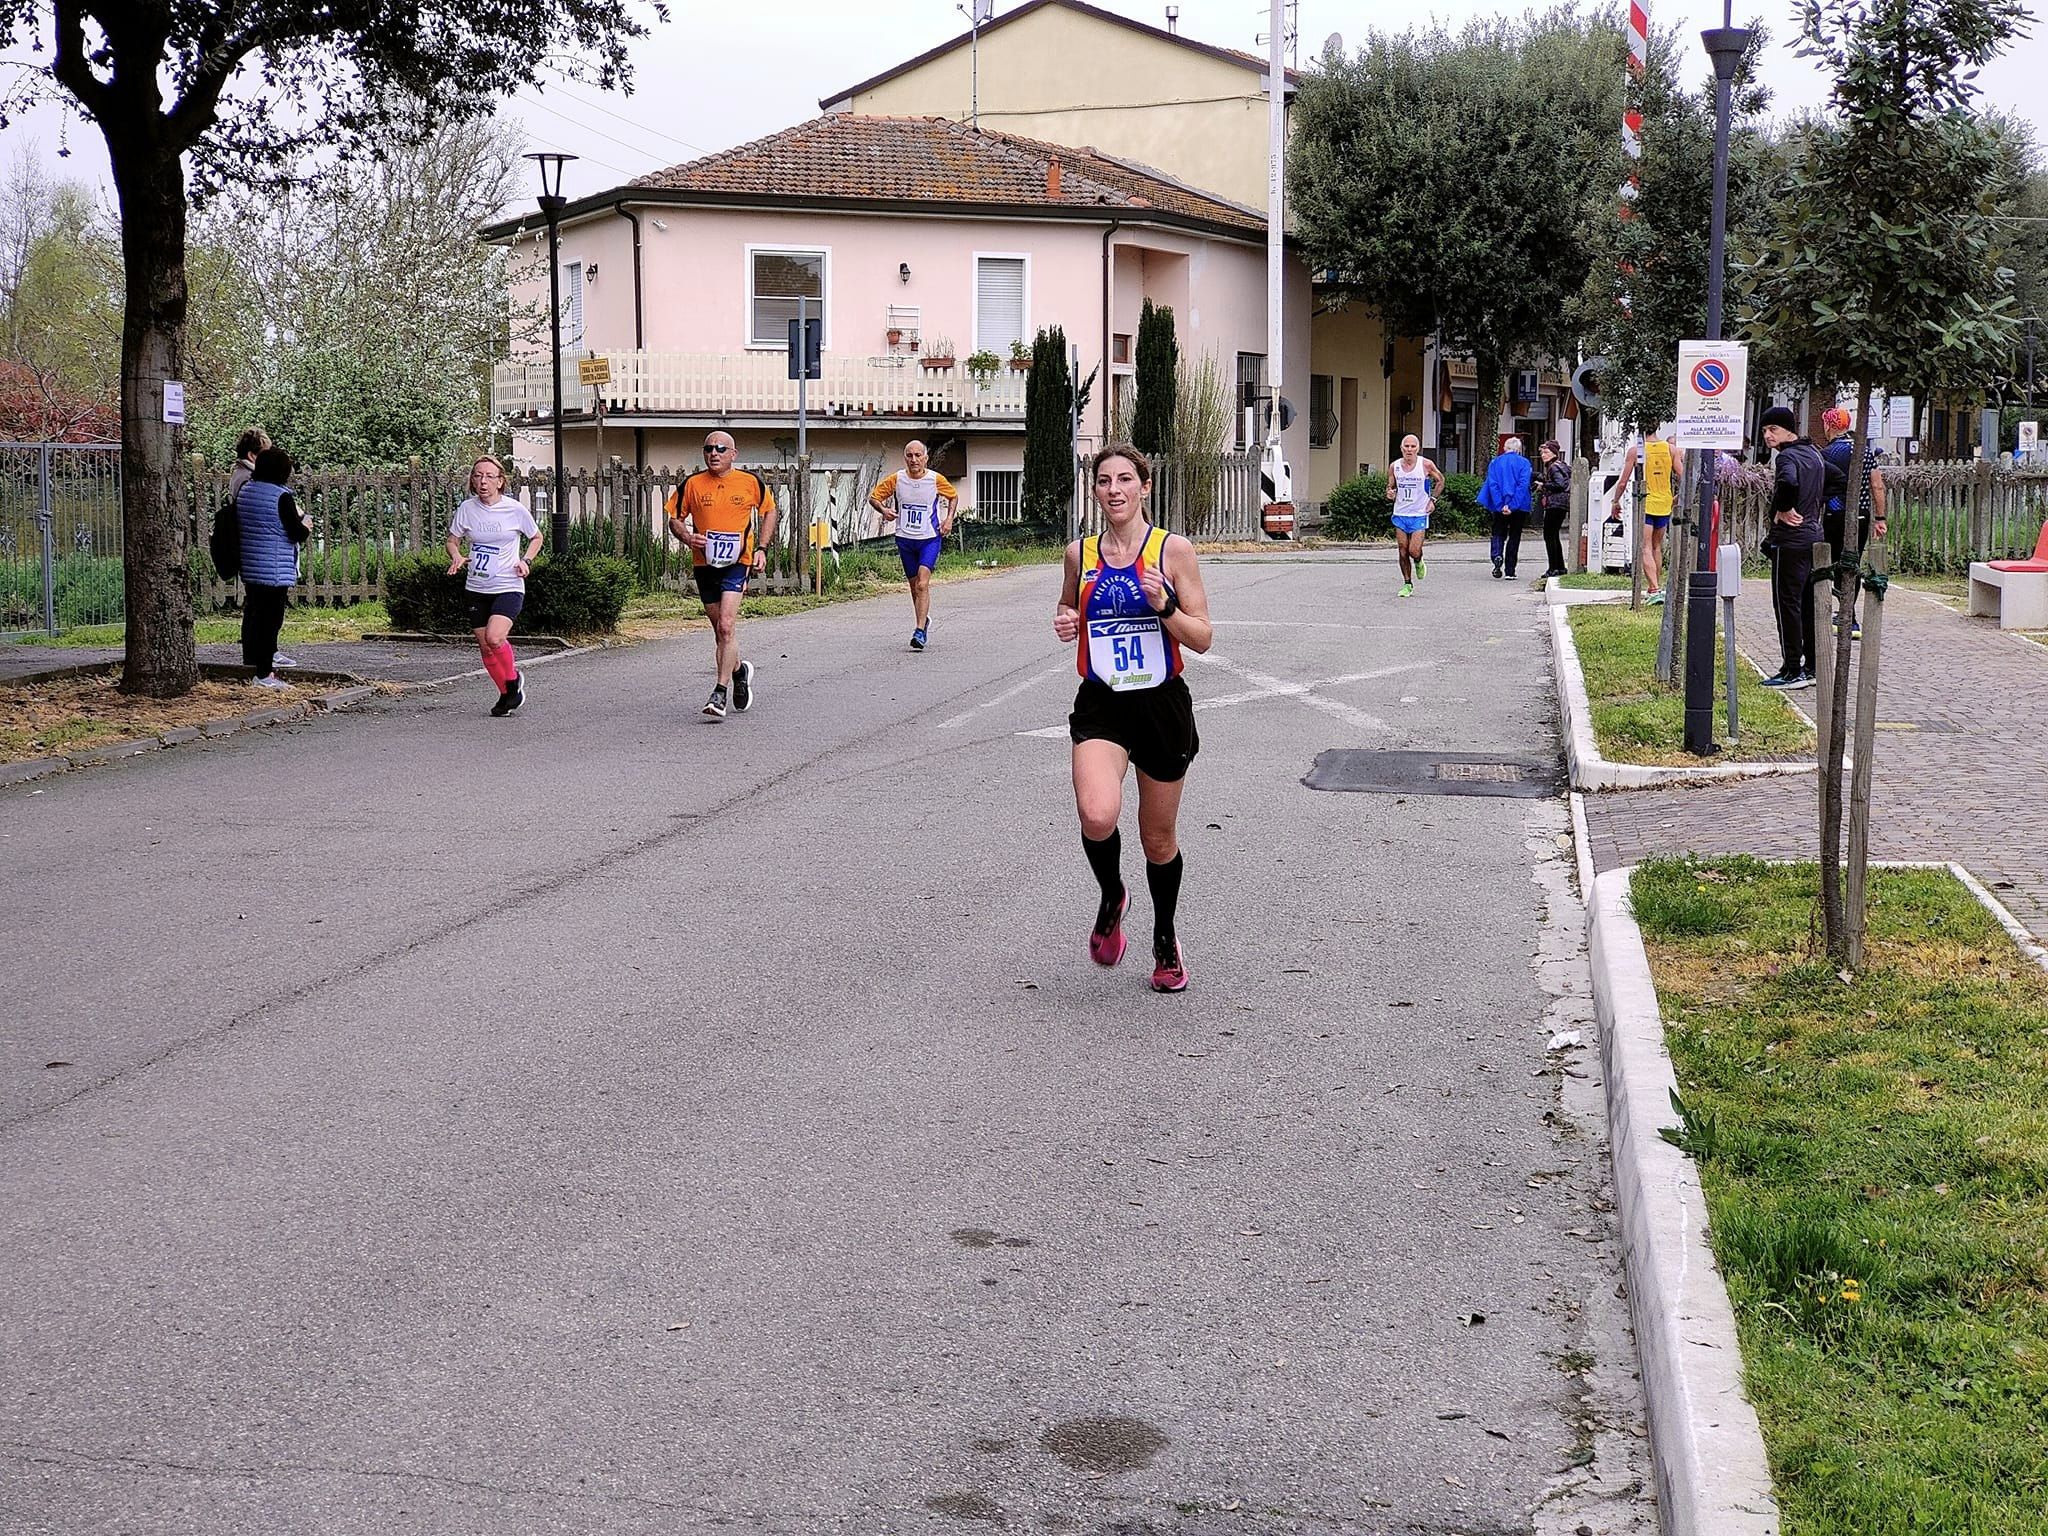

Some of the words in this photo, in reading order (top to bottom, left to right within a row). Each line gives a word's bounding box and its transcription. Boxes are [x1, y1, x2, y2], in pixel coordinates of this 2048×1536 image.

[1404, 488, 1411, 498] 17
[907, 510, 922, 525] 104
[713, 541, 734, 559] 122
[475, 552, 490, 571] 22
[1112, 635, 1145, 672] 54
